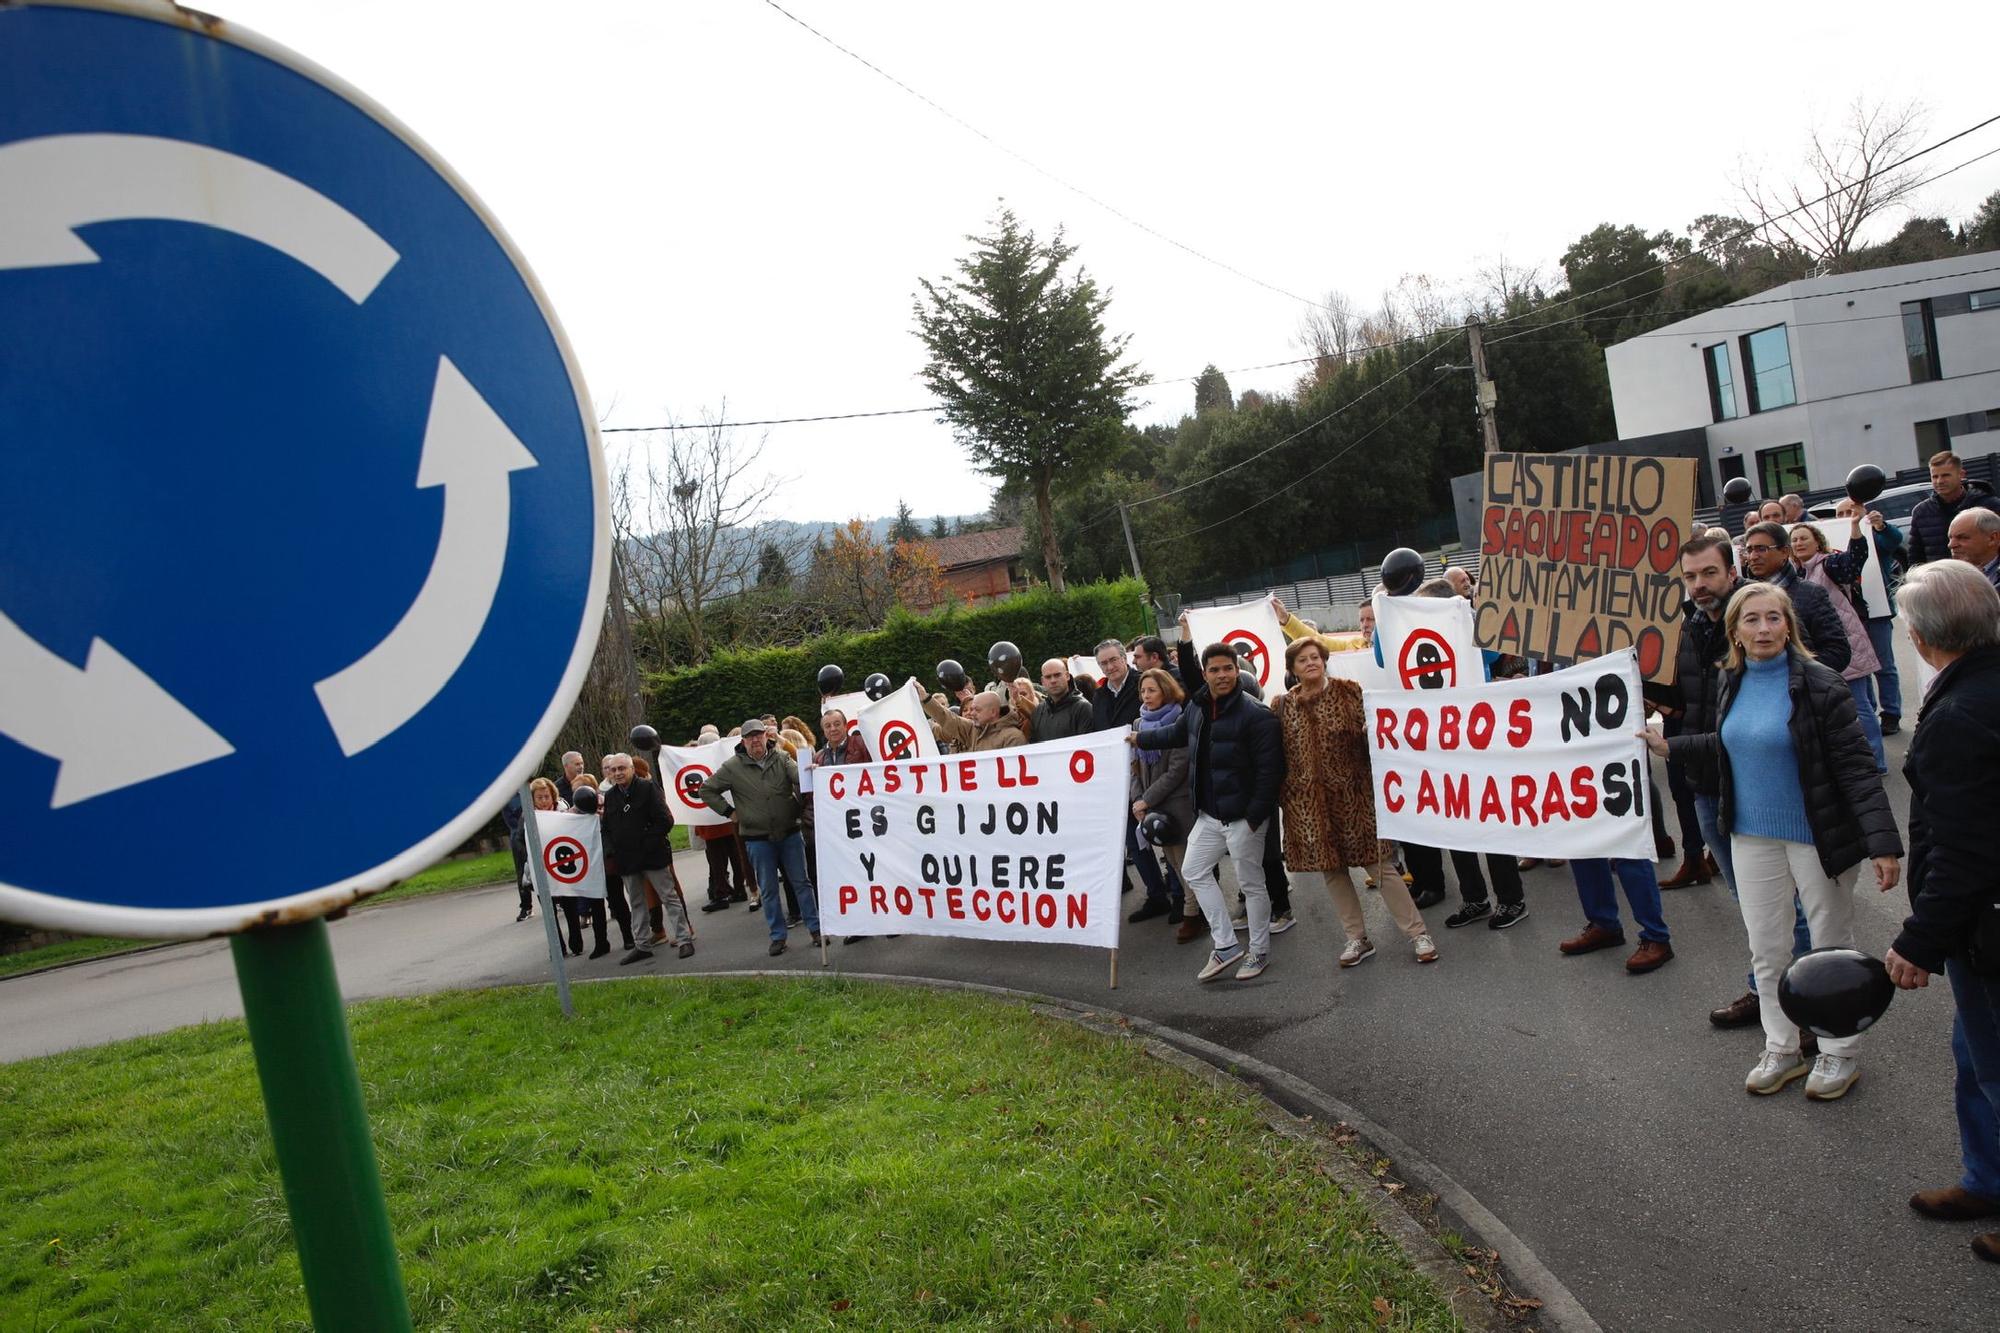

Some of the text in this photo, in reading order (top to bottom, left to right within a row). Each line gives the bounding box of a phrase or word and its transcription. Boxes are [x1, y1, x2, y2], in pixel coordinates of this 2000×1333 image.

[1488, 454, 1665, 516] CASTIELLO
[1483, 505, 1680, 574] SAQUEADO
[1478, 556, 1686, 623] AYUNTAMIENTO
[1473, 602, 1664, 679] CALLADO
[1376, 673, 1629, 751] ROBOS NO
[845, 801, 1058, 839] ES GIJON
[859, 852, 1066, 890] Y QUIERE
[838, 885, 1088, 929] PROTECCION
